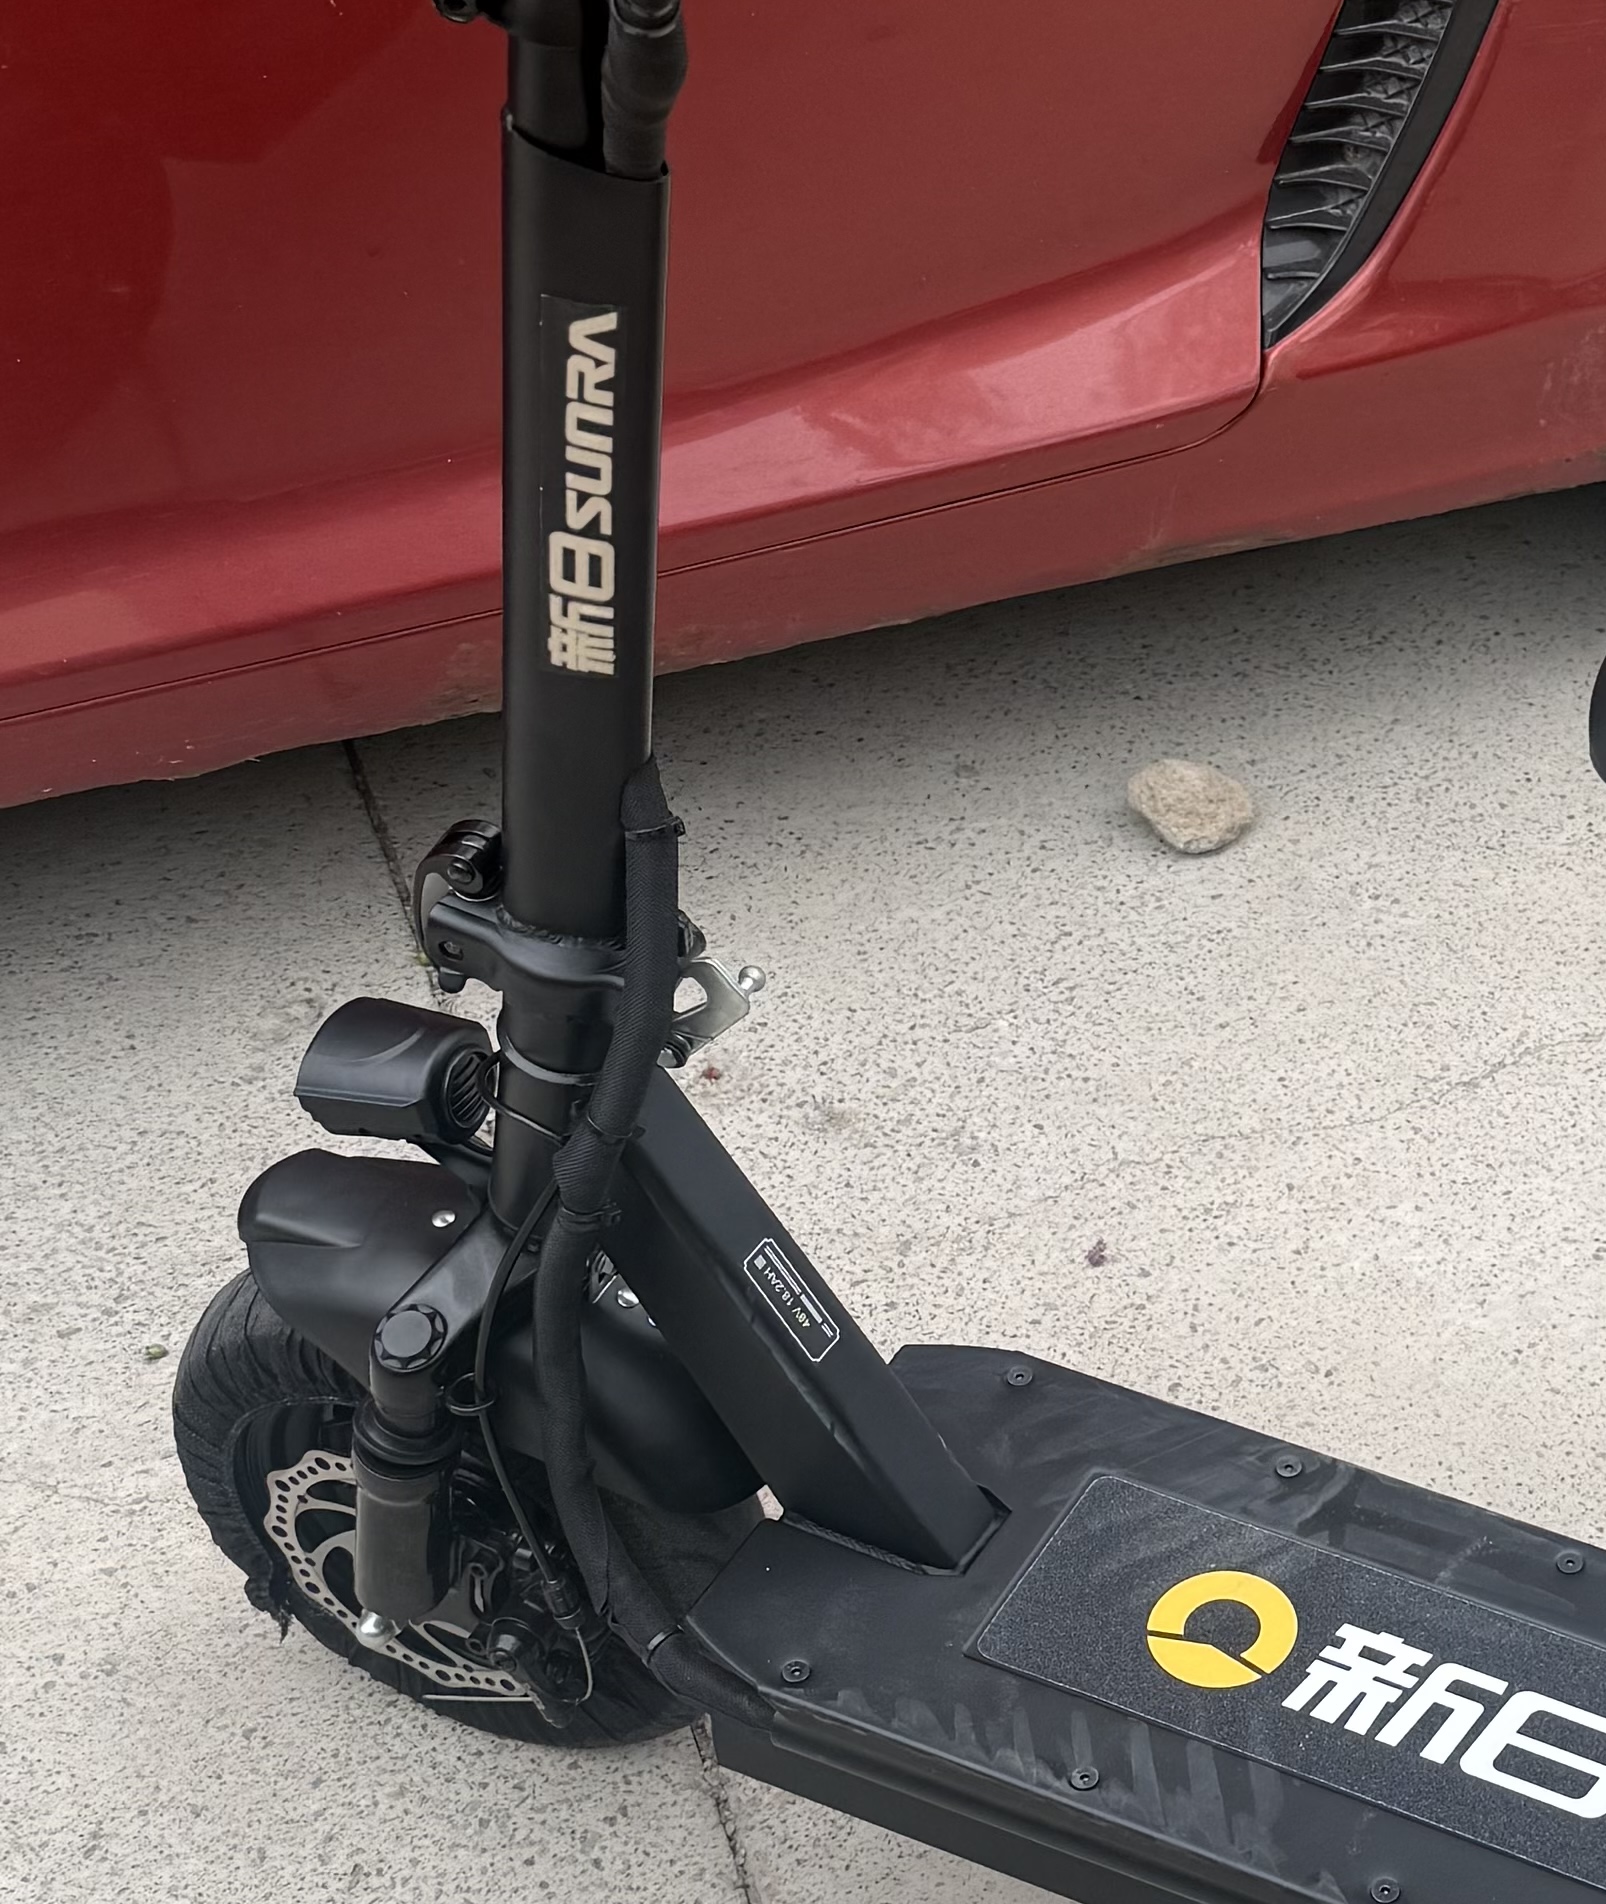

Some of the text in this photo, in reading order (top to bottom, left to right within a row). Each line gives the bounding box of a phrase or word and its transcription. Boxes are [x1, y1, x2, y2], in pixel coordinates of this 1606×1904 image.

[547, 311, 618, 676] 新日 SUNRA
[763, 1267, 811, 1328] 48V 18.2AH
